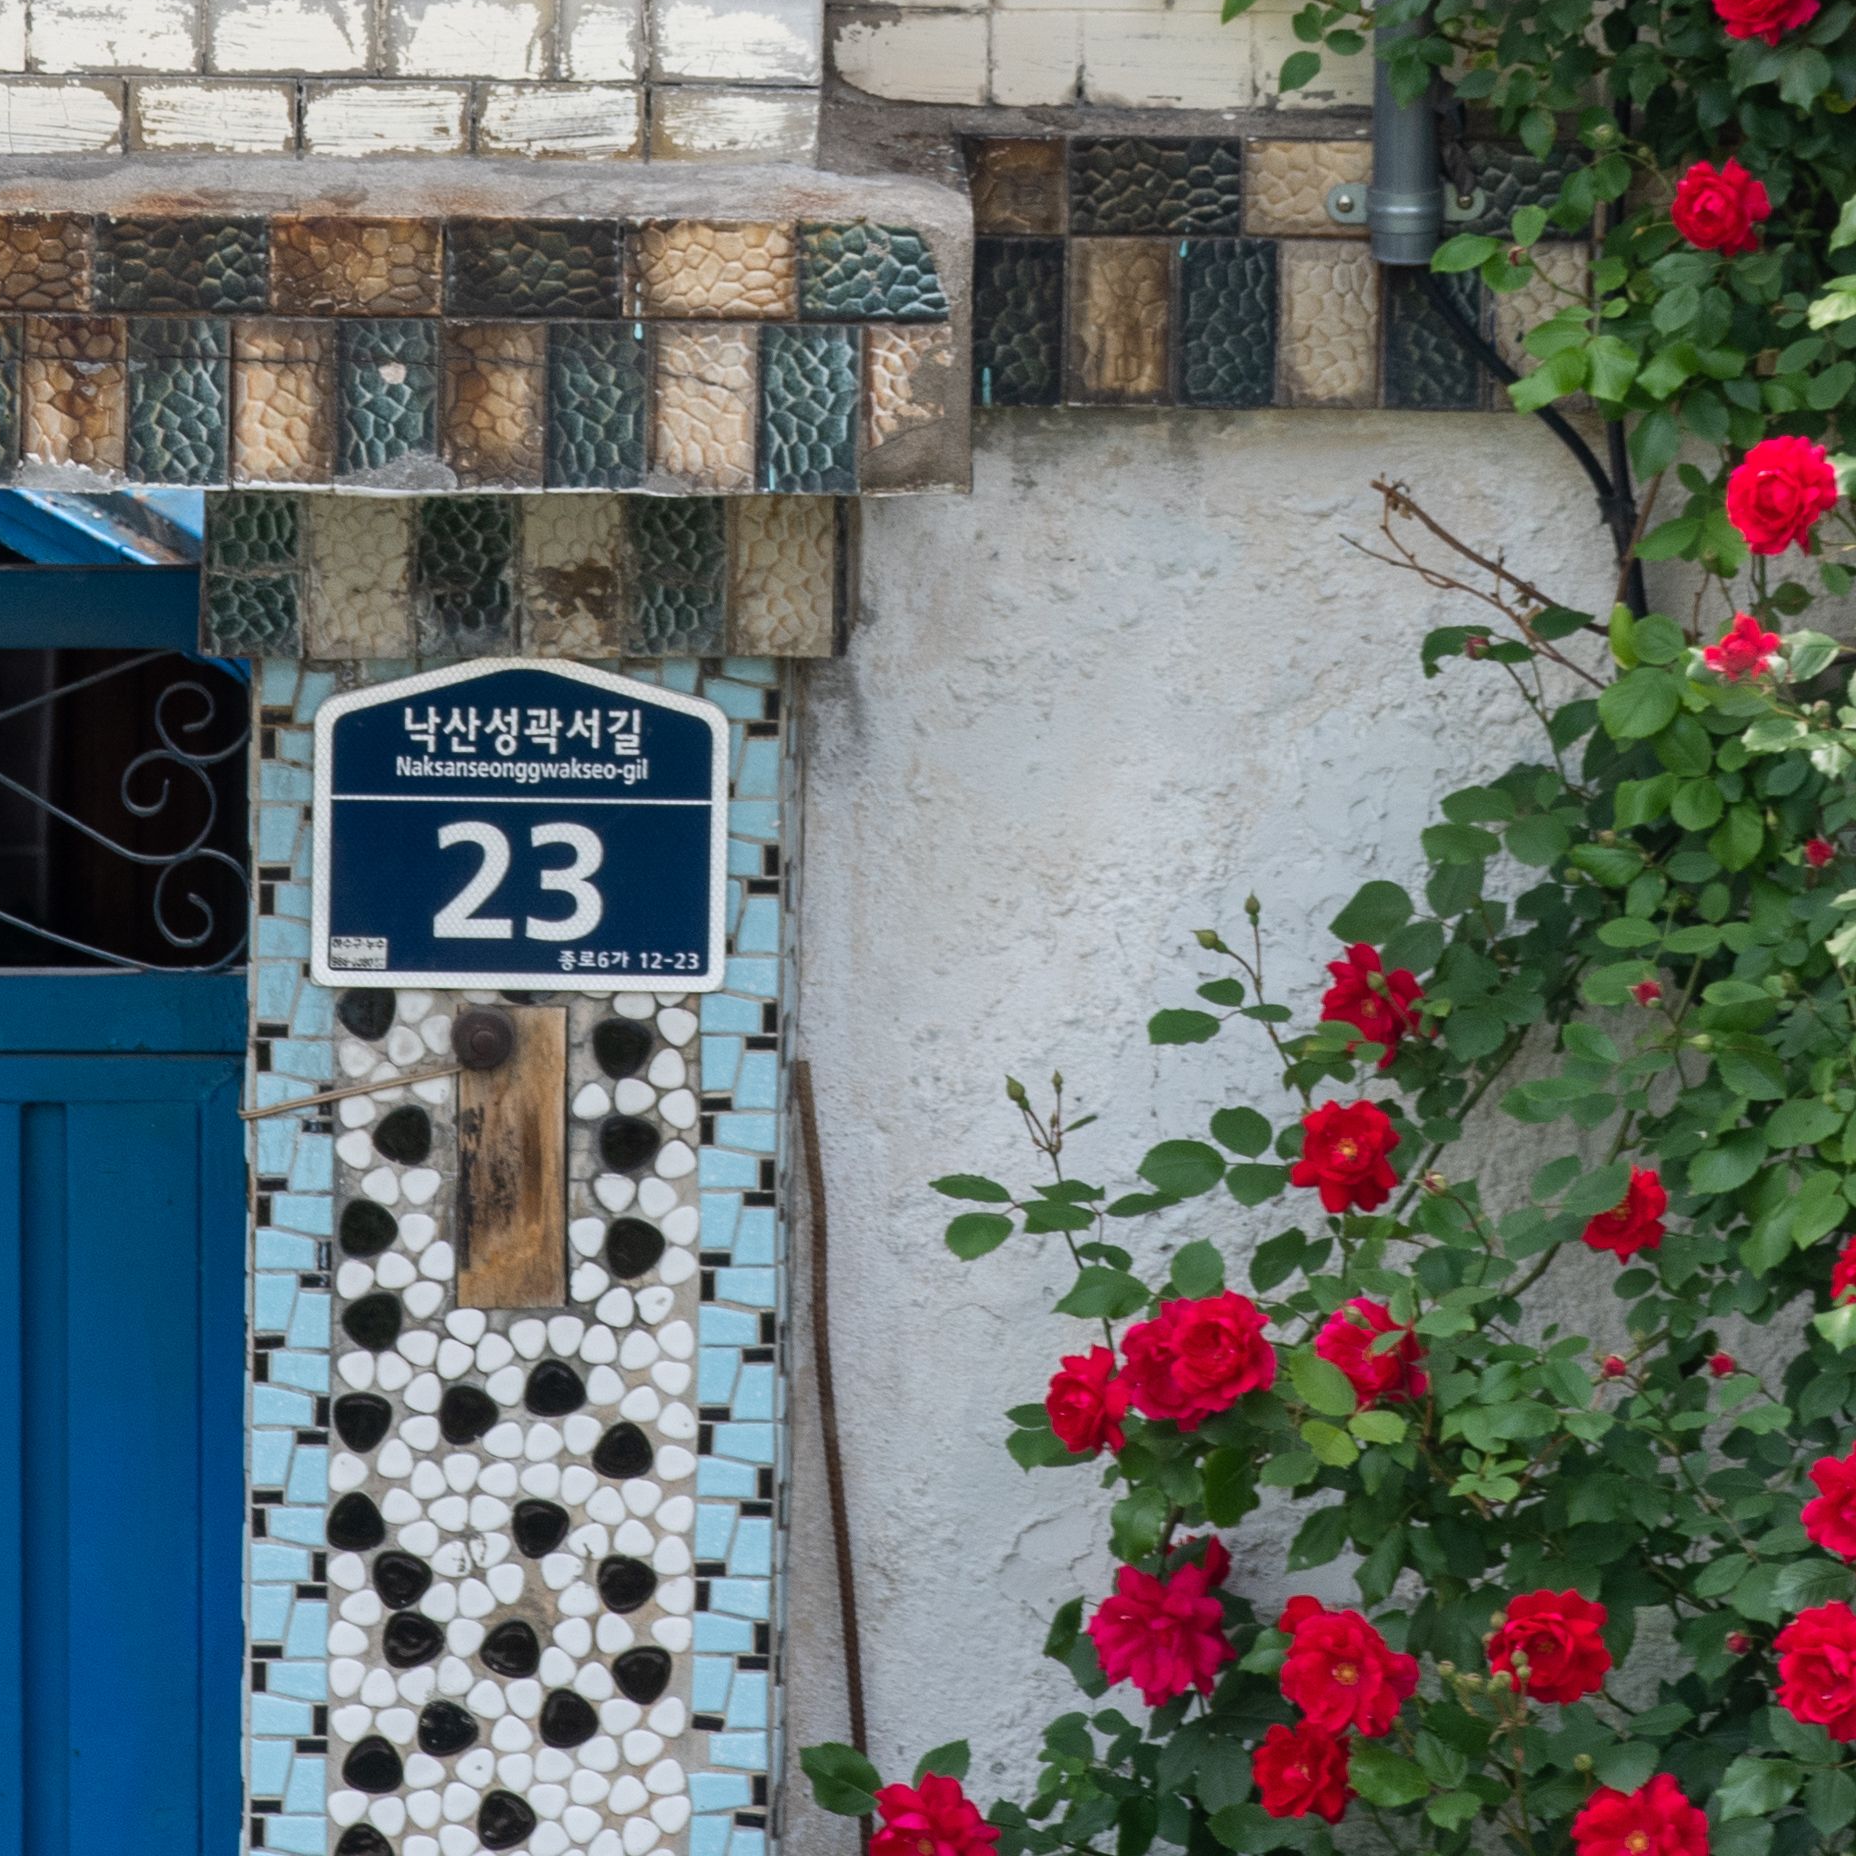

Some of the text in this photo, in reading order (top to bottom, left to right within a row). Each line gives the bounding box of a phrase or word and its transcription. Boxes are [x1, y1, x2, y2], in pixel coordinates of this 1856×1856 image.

[404, 706, 641, 756] 낙산성곽서길
[396, 755, 649, 785] Naksanseonggwakseo-gil
[432, 821, 604, 942] 23
[558, 950, 700, 971] 종로6가 12-23
